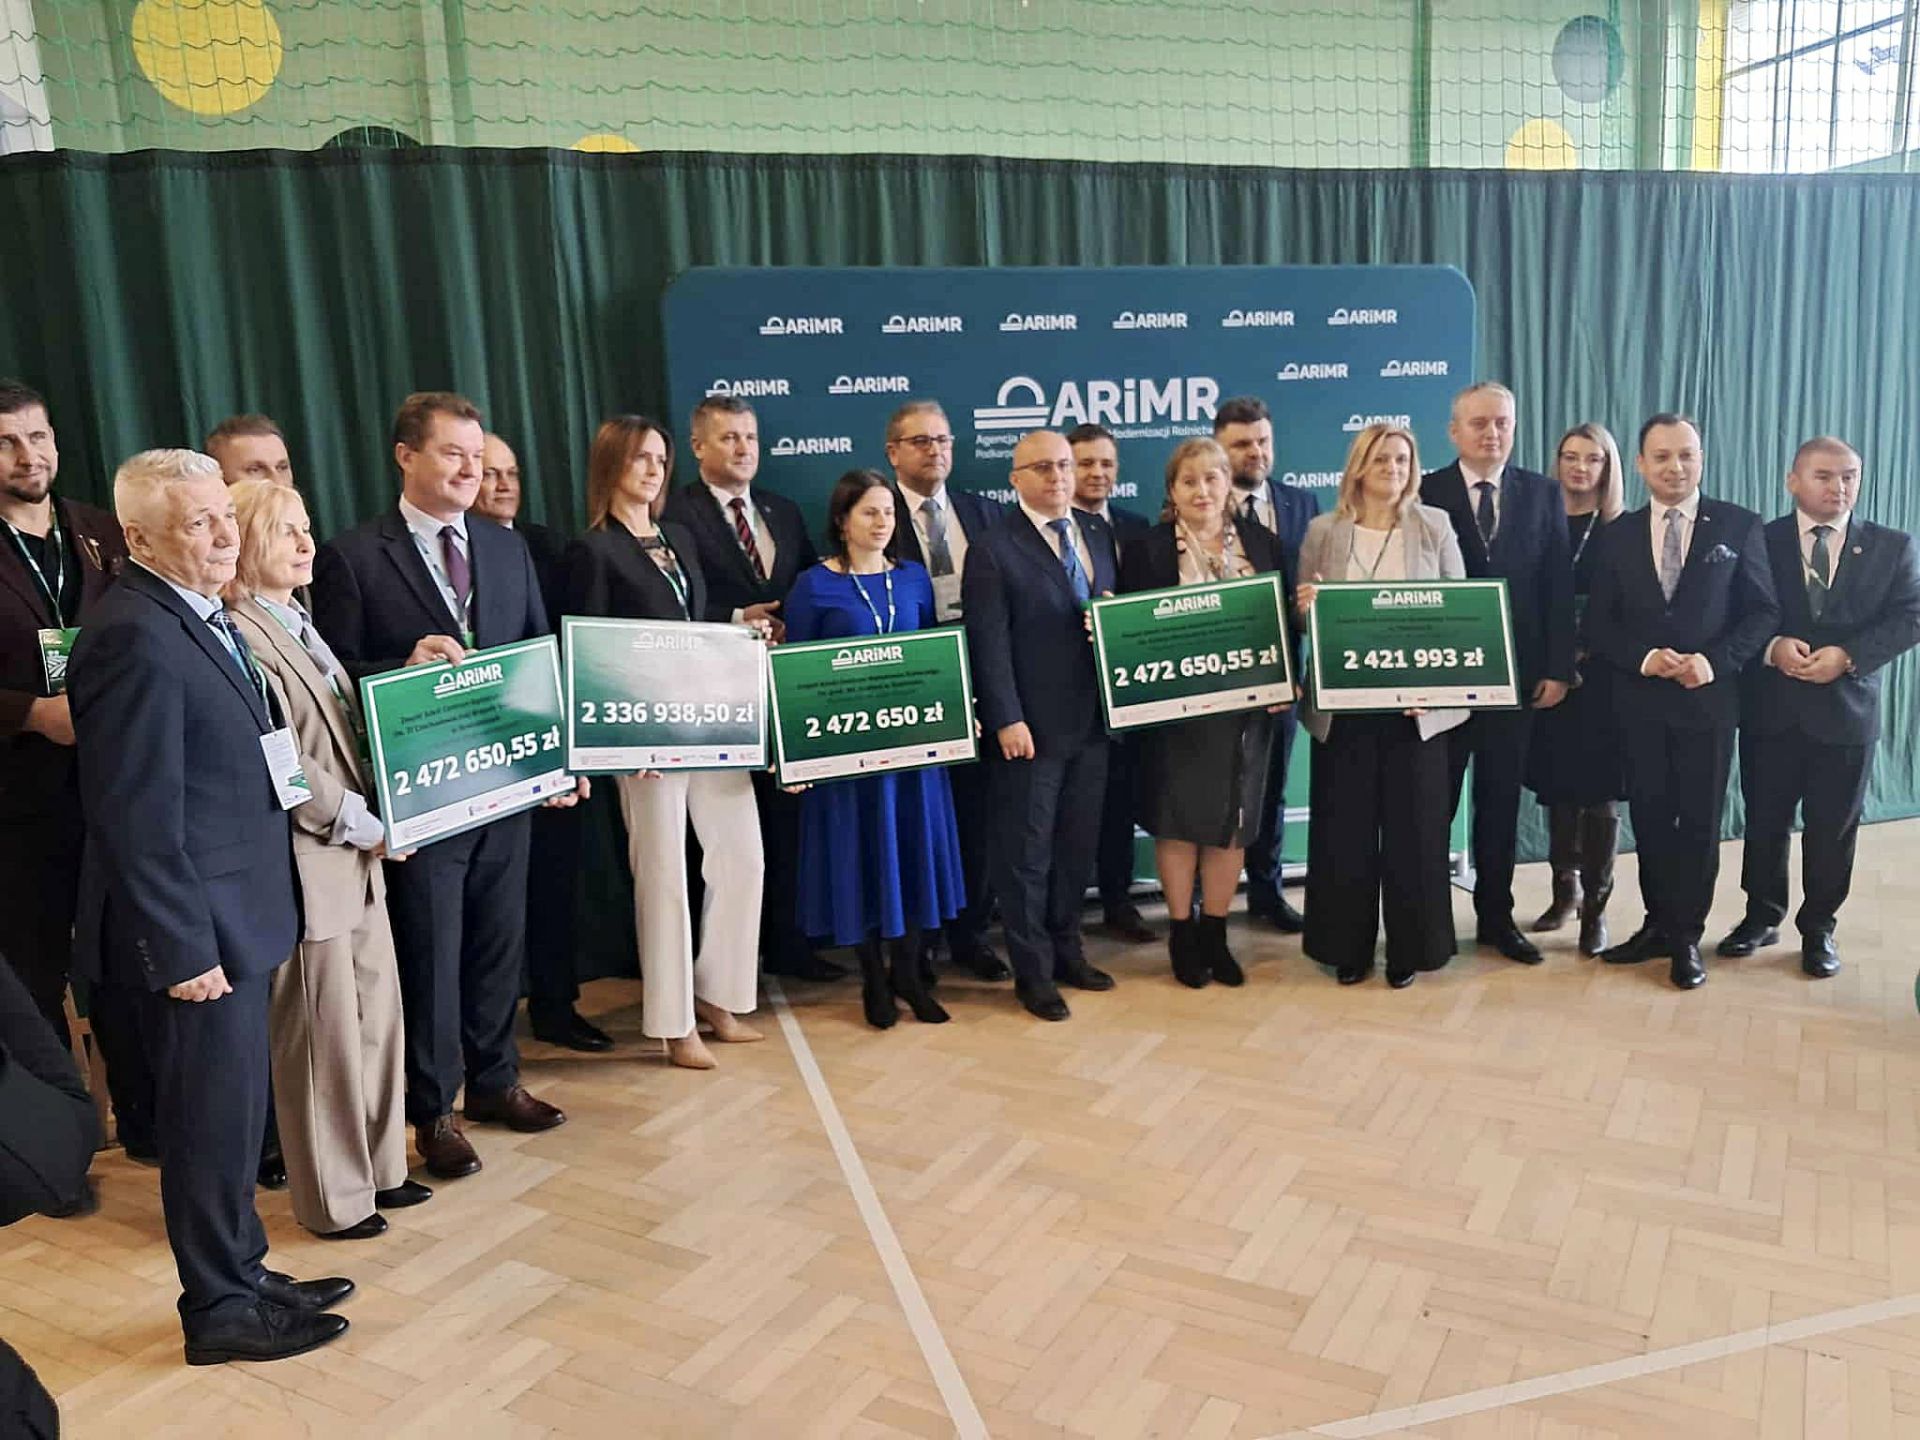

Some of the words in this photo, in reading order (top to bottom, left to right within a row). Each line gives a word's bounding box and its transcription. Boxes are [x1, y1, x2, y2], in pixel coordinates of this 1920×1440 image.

[907, 316, 963, 333] ARiMR
[1024, 314, 1077, 330] ARiMR
[1136, 312, 1188, 328] ARiMR
[1244, 310, 1295, 326] ARiMR
[1350, 309, 1398, 324] ARiMR
[786, 317, 843, 335] ARiMR
[1300, 363, 1349, 379] ARiMR
[1401, 361, 1448, 376] ARiMR
[732, 379, 791, 397] ARiMR
[854, 376, 910, 393] ARiMR
[1051, 377, 1220, 426] ARiMR
[975, 434, 1018, 447] Agencja
[1171, 425, 1214, 436] Rolnictw
[796, 437, 852, 455] ARiMR
[1174, 593, 1222, 612] ARiMR
[1394, 590, 1444, 605] ARiMR
[853, 645, 904, 664] ARiMR
[1343, 651, 1359, 670] 2
[1364, 650, 1408, 669] 421
[1414, 649, 1458, 668] 993
[1463, 647, 1485, 667] zł
[1114, 667, 1129, 687] 2
[1133, 660, 1176, 683] 472
[1180, 649, 1254, 677] 650,55
[1259, 645, 1278, 665] zł
[455, 663, 504, 689] ARiMR
[581, 702, 597, 723] 2
[603, 702, 648, 723] 336
[653, 703, 730, 727] 938,50
[735, 703, 754, 723] zł
[805, 717, 822, 738] 2
[826, 711, 870, 735] 472
[876, 705, 919, 729] 650
[924, 701, 944, 722] zł
[393, 770, 411, 796] 2
[415, 756, 461, 788] 472
[464, 732, 538, 774] 650,55
[542, 725, 561, 751] zł
